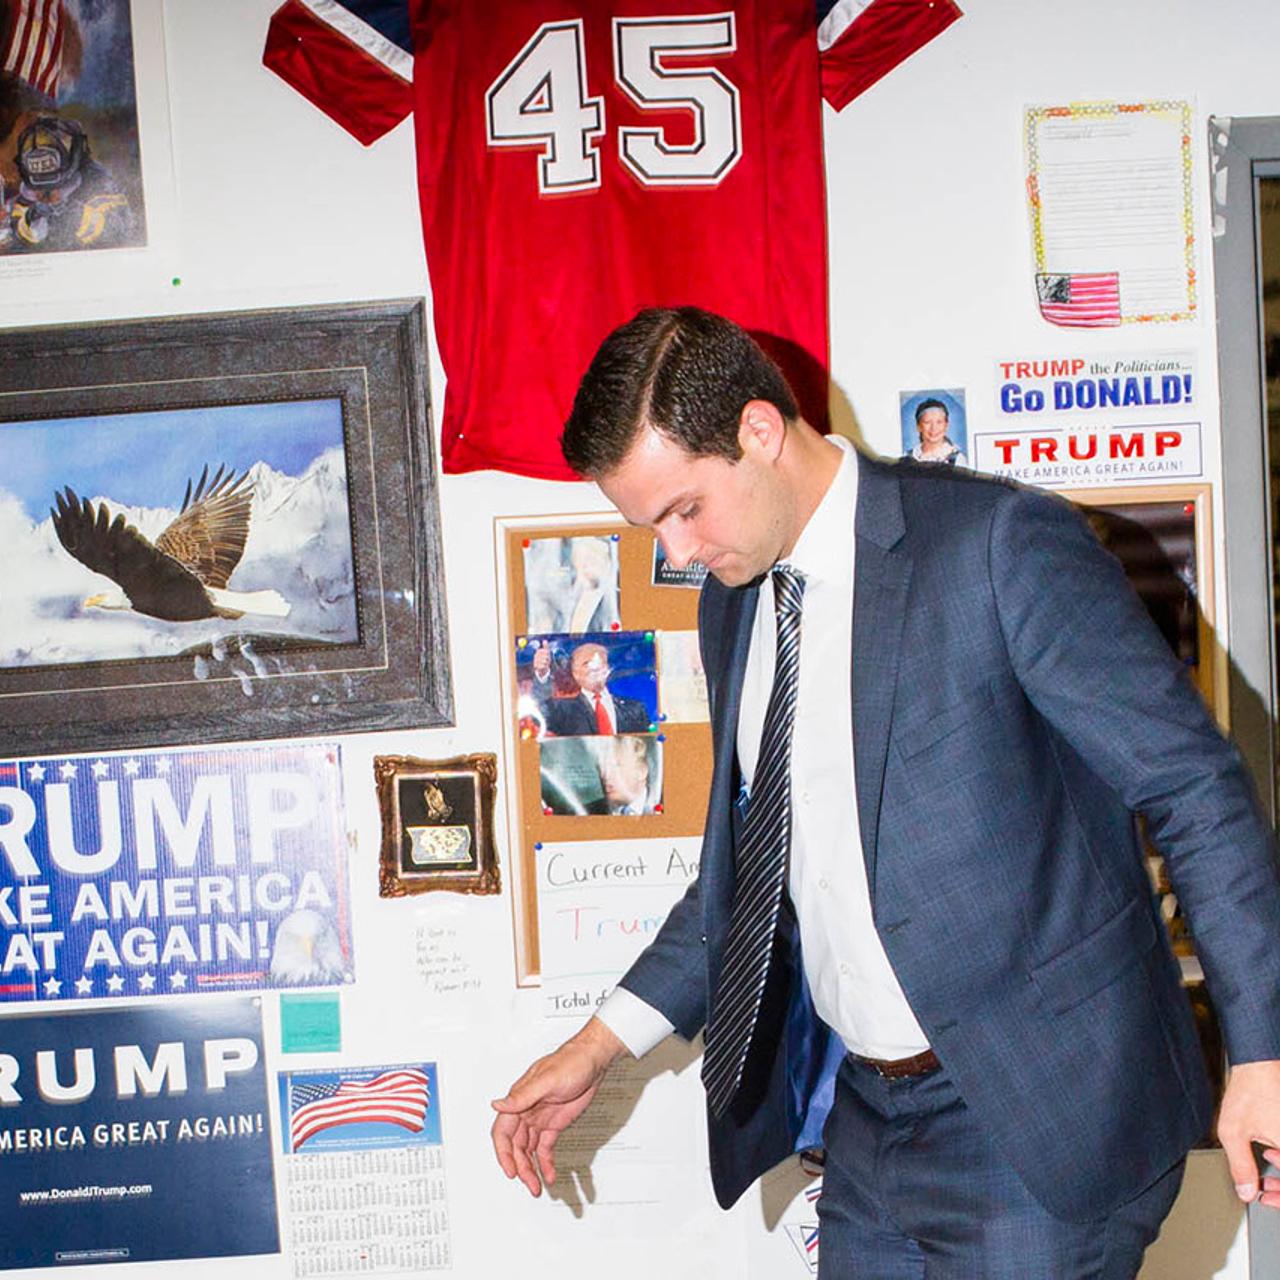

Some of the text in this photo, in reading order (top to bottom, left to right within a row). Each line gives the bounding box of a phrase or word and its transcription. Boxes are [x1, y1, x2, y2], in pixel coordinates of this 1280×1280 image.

[485, 11, 742, 194] 45
[1000, 359, 1193, 380] TRUMP the Politicians...
[1000, 374, 1193, 414] Go DONALD!
[994, 431, 1182, 464] TRUMP
[1034, 464, 1091, 479] AMERICA
[1095, 462, 1135, 475] GREAT
[1139, 459, 1183, 473] AGAIN!
[546, 853, 648, 887] Current
[72, 870, 333, 922] AMERICA
[84, 921, 269, 970] AGAIN!
[547, 992, 590, 1010] Total
[93, 1120, 171, 1145] GREAT
[177, 1113, 264, 1139] AGAIN!
[20, 1183, 153, 1202] www.DonaldJTrump.com
